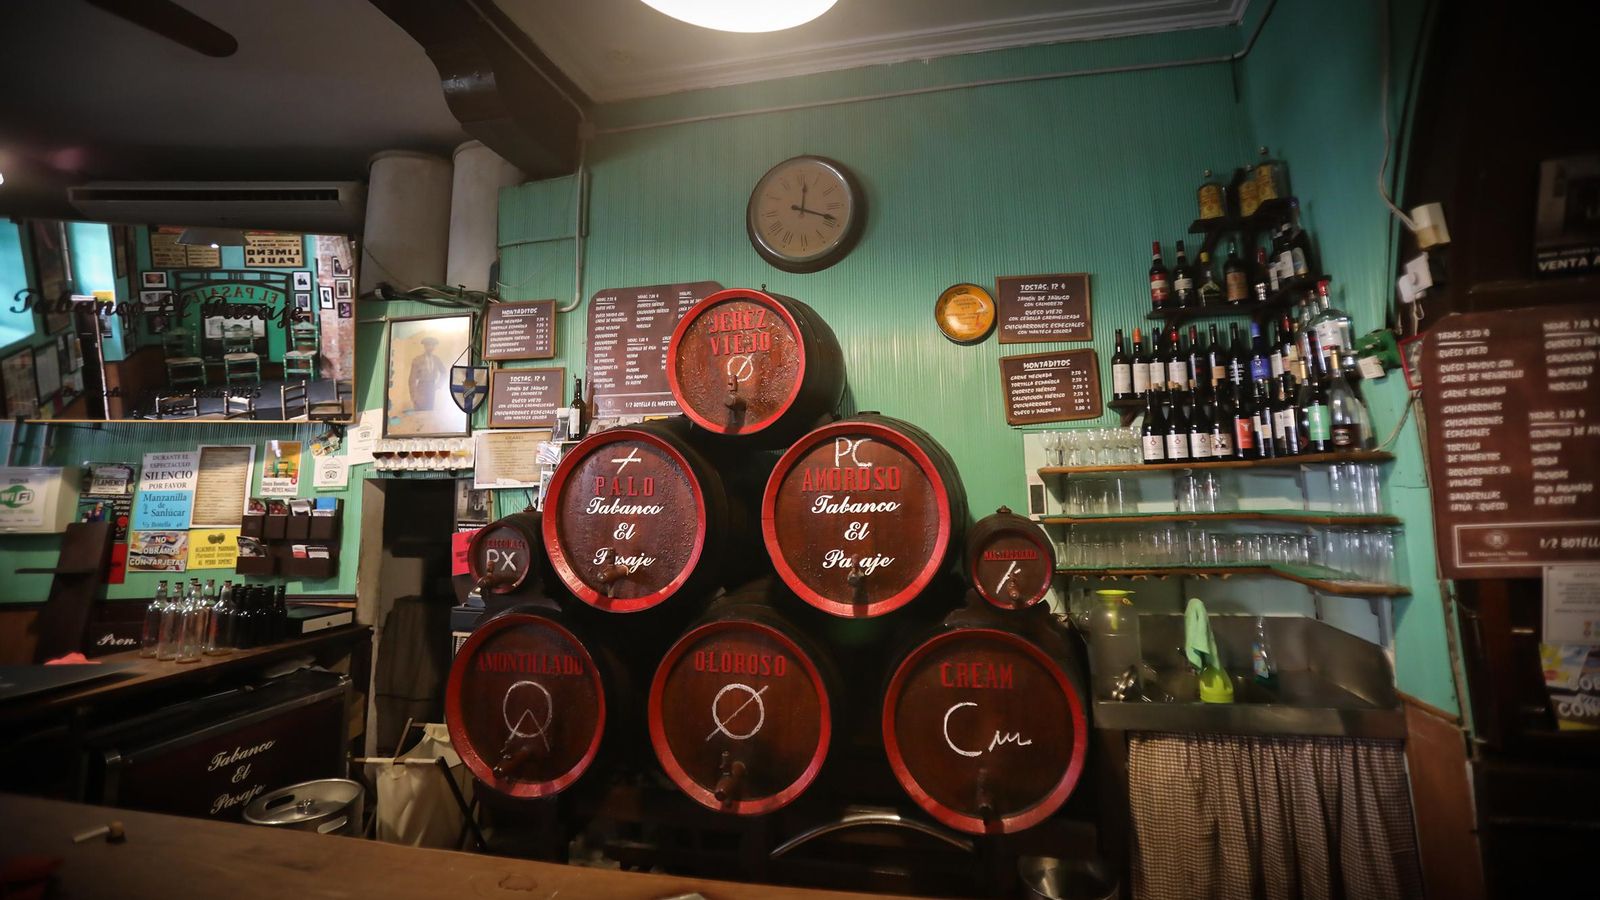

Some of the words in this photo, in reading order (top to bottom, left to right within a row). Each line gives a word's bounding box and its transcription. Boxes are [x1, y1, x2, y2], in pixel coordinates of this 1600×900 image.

[1538, 257, 1588, 271] VENTA
[502, 307, 538, 315] MONTADITOS
[709, 308, 768, 333] JEREZ
[710, 332, 771, 356] VIEJO
[1439, 348, 1464, 359] QUESO
[1465, 346, 1489, 355] VIEJO
[1023, 359, 1071, 369] MONTADITOS
[1440, 362, 1465, 373] QUESO
[1498, 359, 1515, 368] CON
[1441, 374, 1466, 384] CARNE
[1468, 373, 1479, 382] DE
[1442, 389, 1468, 399] CARNE
[1443, 402, 1503, 414] CHICHARRONES
[1444, 416, 1504, 428] CHICHARRONES
[1445, 428, 1490, 439] ESPECIALES
[834, 437, 873, 468] PC
[1448, 454, 1459, 463] DE
[145, 470, 193, 481] SILENCIO
[801, 466, 902, 492] AMOROSO
[1448, 466, 1499, 477] BOQUERONES
[1500, 466, 1512, 474] EN
[595, 476, 655, 497] PALO
[1448, 478, 1483, 488] VINAGRE
[143, 493, 187, 502] Manzanilla
[1450, 491, 1501, 501] BANDERILLAS
[586, 497, 664, 515] Tabanco
[811, 495, 901, 514] Tabanco
[613, 522, 635, 540] El
[844, 521, 870, 541] El
[1540, 538, 1559, 549] 1/2
[486, 548, 517, 572] PX
[822, 549, 895, 576] Paaje
[479, 652, 584, 675] AMONTILLADO
[695, 650, 788, 677] OLOROSO
[940, 662, 1014, 689] CREAM
[208, 739, 276, 772] Tabanco
[231, 763, 251, 784] El
[210, 783, 266, 815] Pasaje
